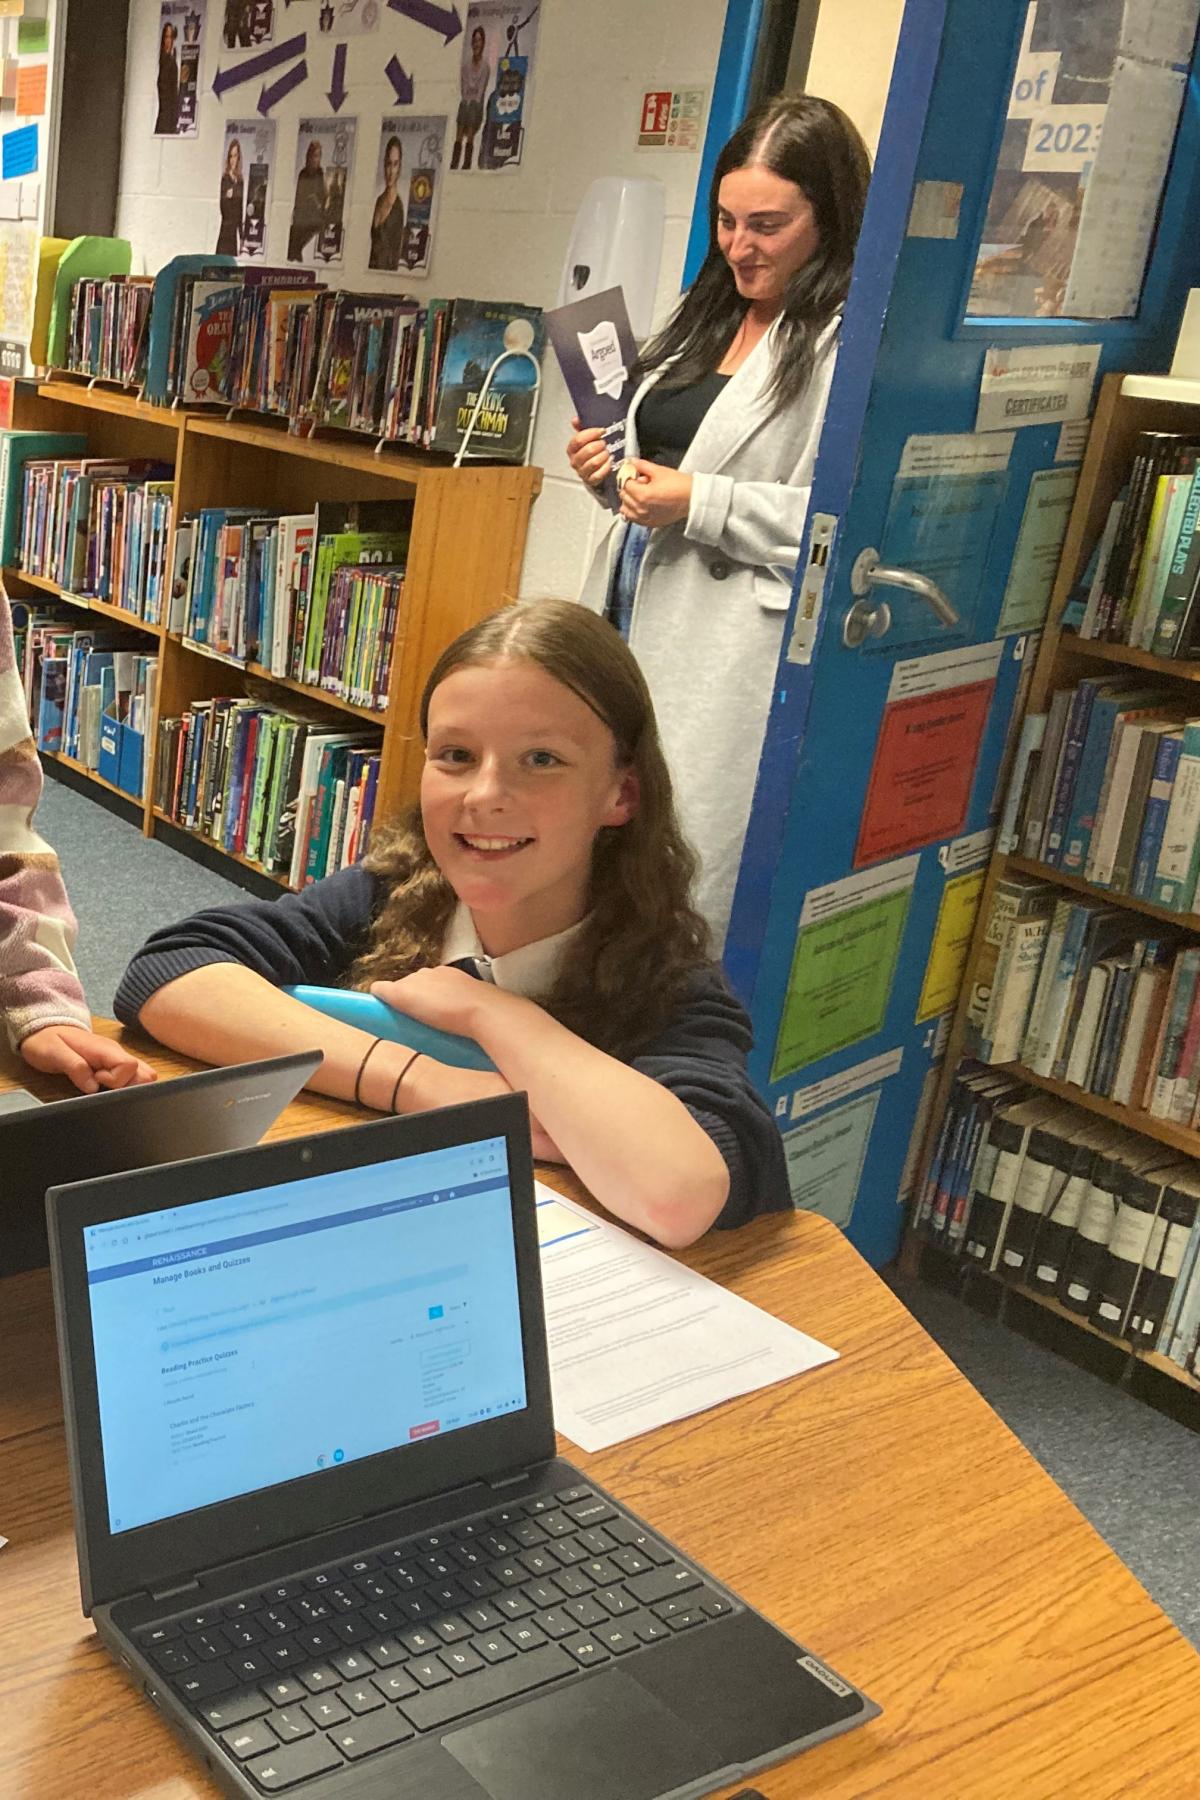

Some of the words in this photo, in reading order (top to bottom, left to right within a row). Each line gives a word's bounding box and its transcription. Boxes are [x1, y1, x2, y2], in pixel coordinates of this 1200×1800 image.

[1015, 70, 1049, 102] of
[1004, 394, 1069, 416] CERTIFICATES
[1172, 538, 1193, 576] PLAYS
[152, 1247, 208, 1266] RENAISSANCE
[153, 1272, 182, 1285] Manage
[184, 1265, 206, 1279] Books
[208, 1262, 222, 1272] and
[223, 1256, 251, 1269] Quizzes
[161, 1362, 187, 1374] Reading
[805, 1660, 847, 1692] Lenovo
